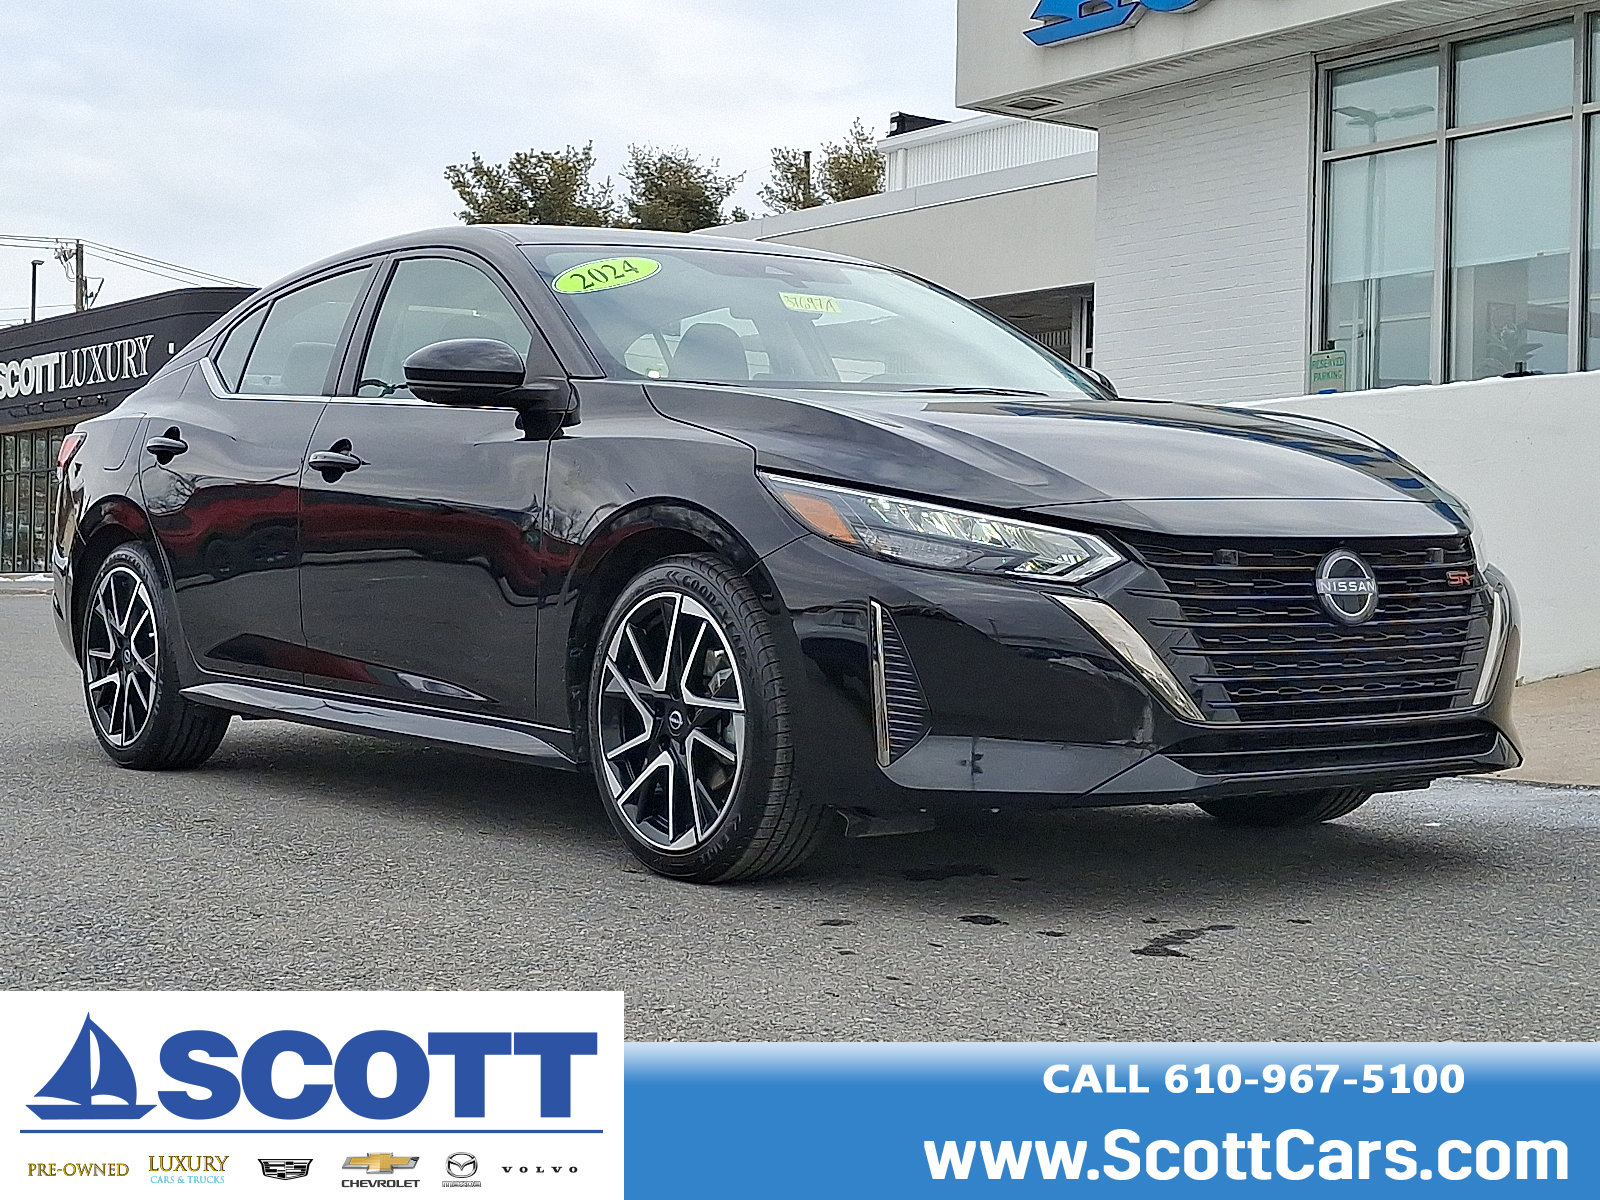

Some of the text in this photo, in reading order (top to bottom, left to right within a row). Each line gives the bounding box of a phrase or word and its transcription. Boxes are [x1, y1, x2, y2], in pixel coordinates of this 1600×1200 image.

[570, 259, 640, 290] 2024
[59, 334, 154, 390] LUXURY
[1312, 356, 1344, 369] RESERVED
[1313, 370, 1342, 382] PARKING
[1447, 571, 1471, 586] SR
[1319, 579, 1376, 593] NISSAN
